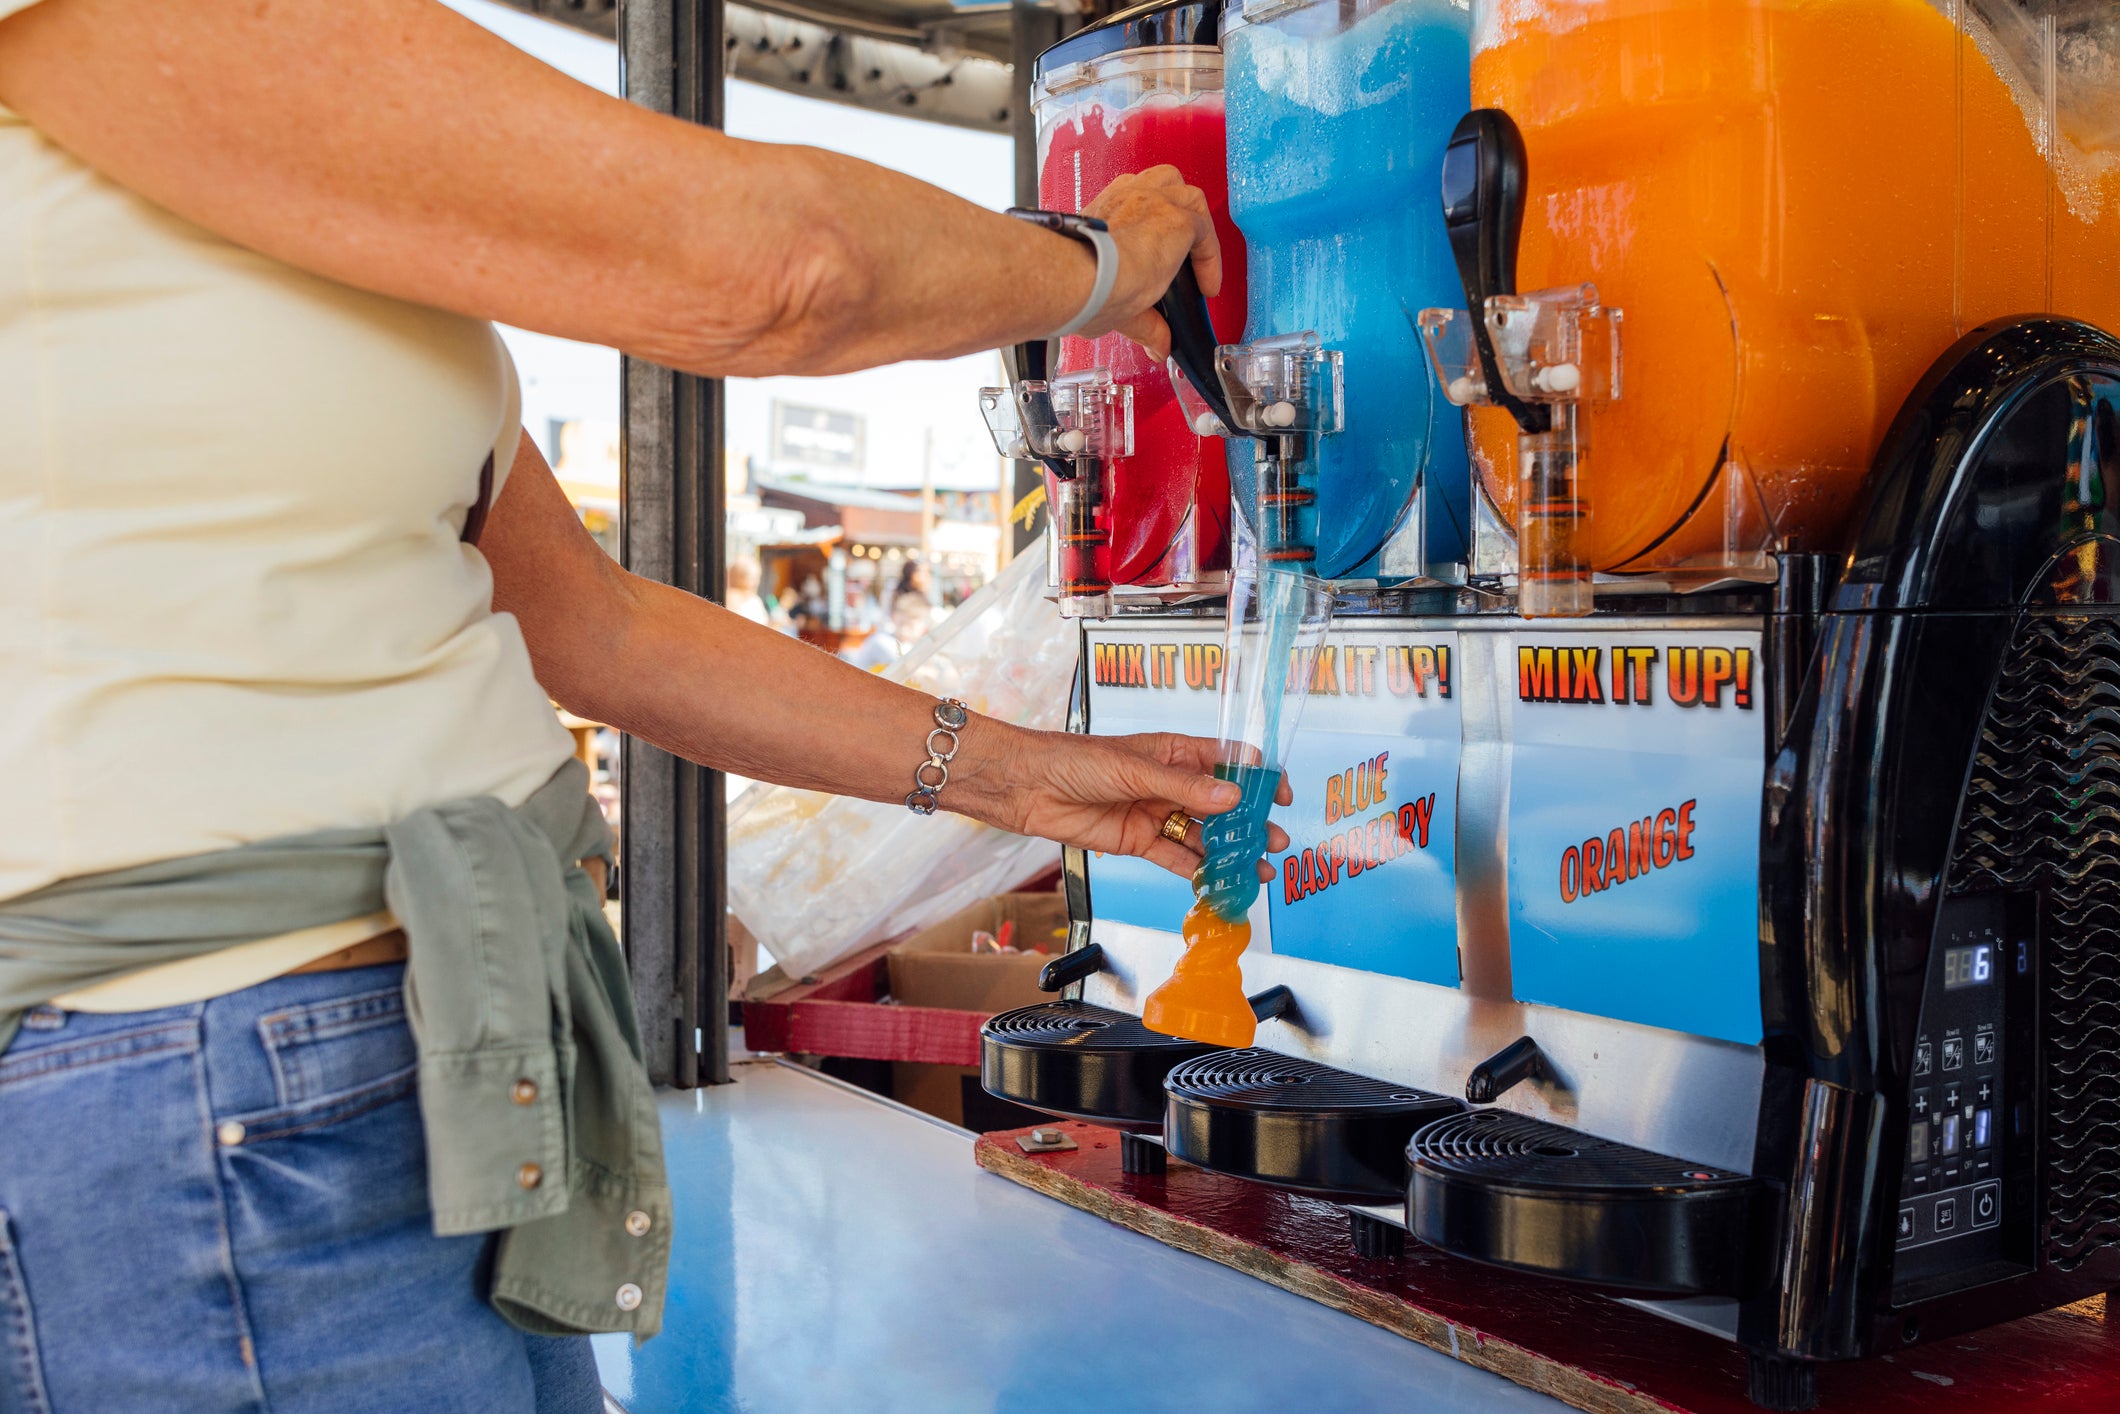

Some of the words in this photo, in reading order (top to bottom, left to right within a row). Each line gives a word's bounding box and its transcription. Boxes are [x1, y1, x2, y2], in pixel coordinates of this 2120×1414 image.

[1095, 642, 1147, 688] MIX
[1151, 643, 1177, 690] IT
[1184, 644, 1229, 691] UP
[1345, 645, 1380, 696] IT
[1386, 645, 1452, 698] UP!
[1518, 646, 1605, 704] MIX
[1611, 646, 1658, 705] IT
[1667, 646, 1753, 709] UP!
[1325, 751, 1389, 825] BLUE
[1283, 792, 1435, 905] RASPBERRY
[1560, 798, 1697, 904] ORANGE
[1974, 947, 1990, 981] 6
